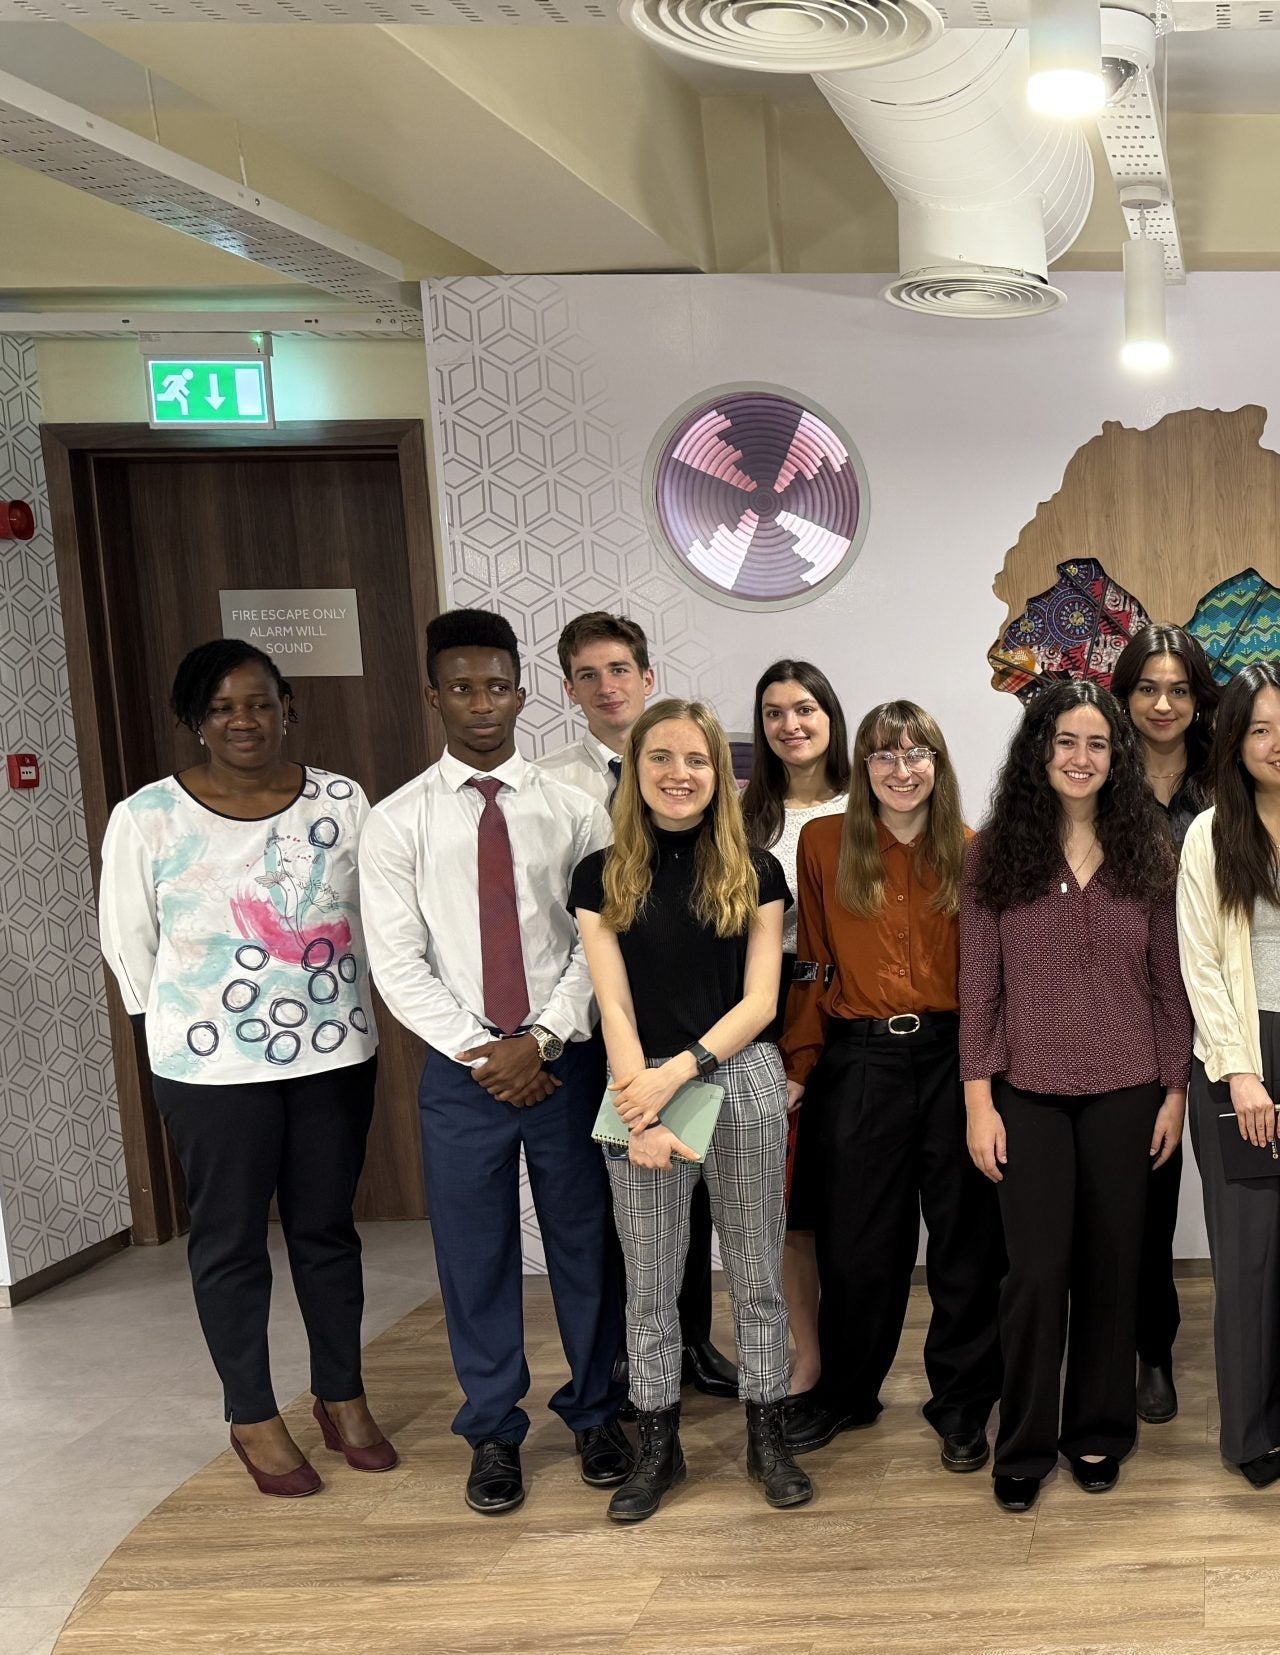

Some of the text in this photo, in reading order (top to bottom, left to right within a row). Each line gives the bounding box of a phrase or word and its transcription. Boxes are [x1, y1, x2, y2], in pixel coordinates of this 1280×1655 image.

[232, 608, 347, 621] FIRE ESCAPE ONLY
[250, 625, 327, 637] ALARM WILL
[265, 642, 313, 653] SOUND
